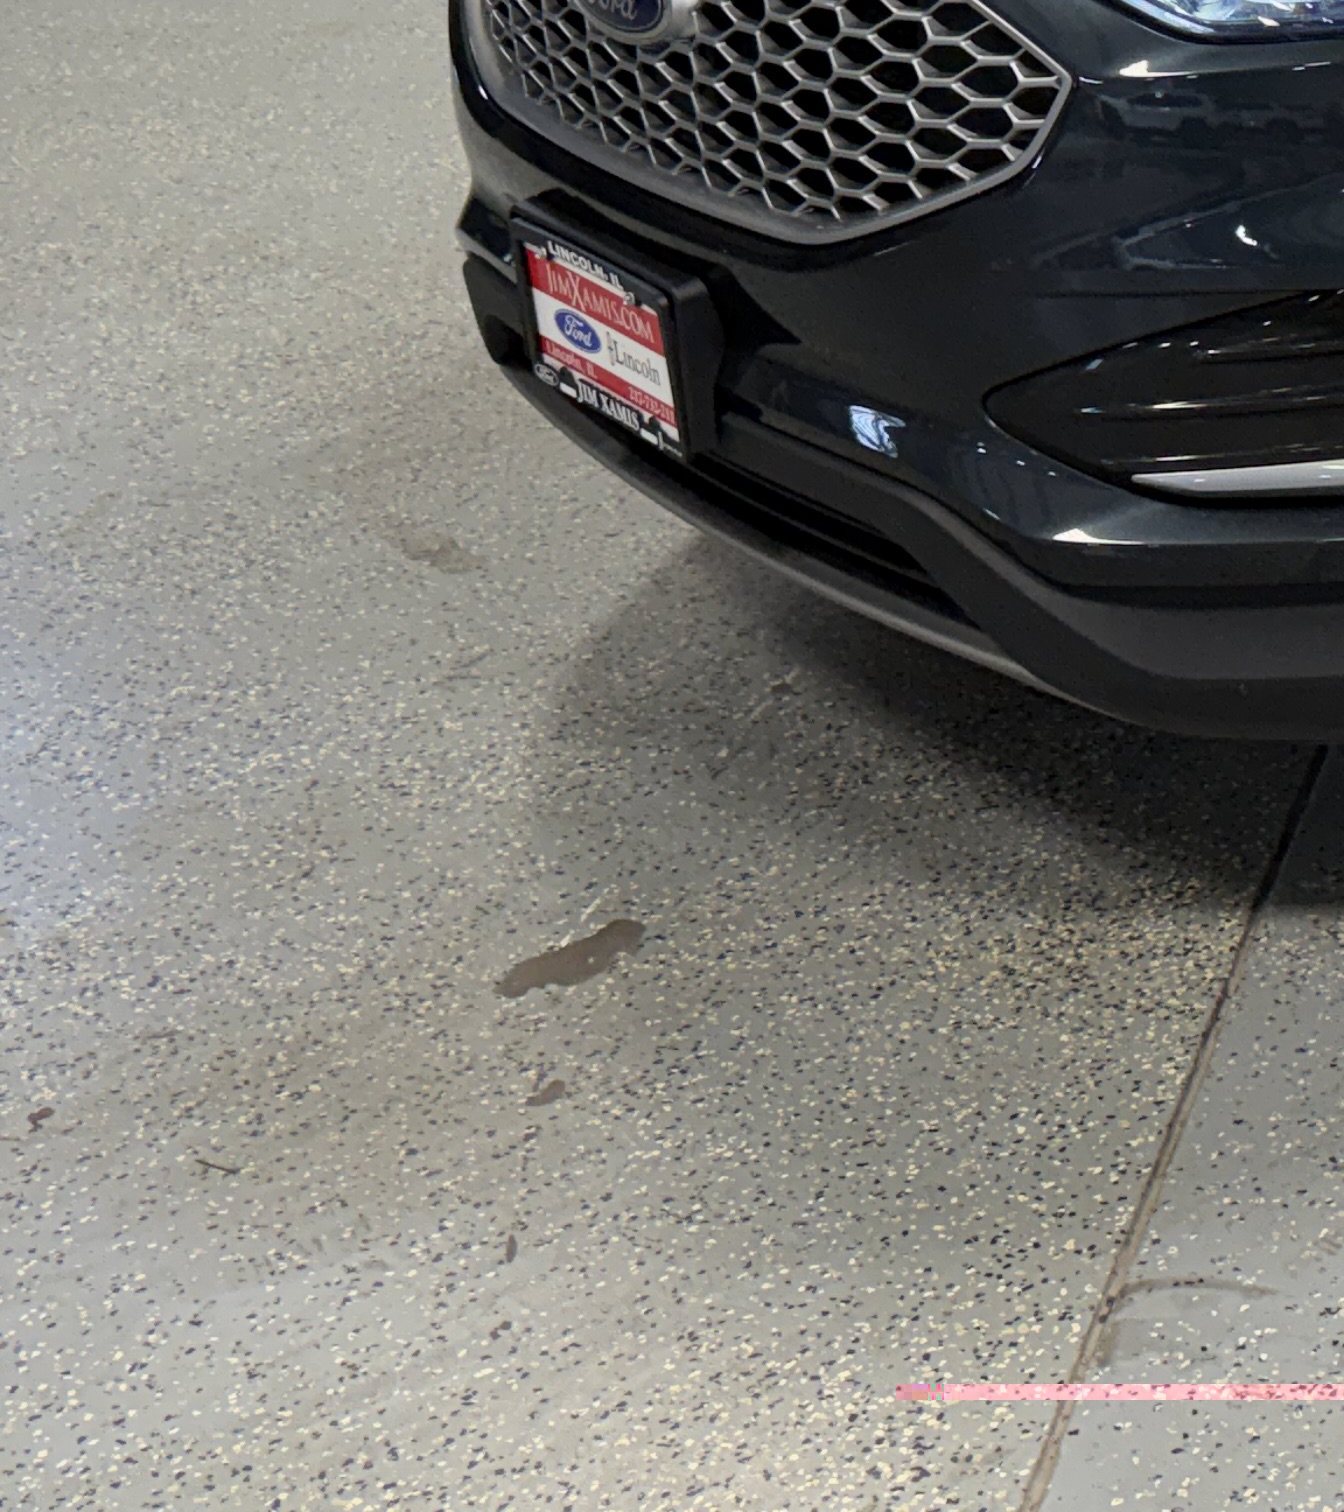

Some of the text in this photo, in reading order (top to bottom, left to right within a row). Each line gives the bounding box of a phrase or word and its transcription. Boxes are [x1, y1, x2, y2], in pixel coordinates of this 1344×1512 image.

[563, 313, 594, 348] Ford
[614, 340, 662, 386] Lincoln
[576, 380, 640, 432] JIM XAMIS
